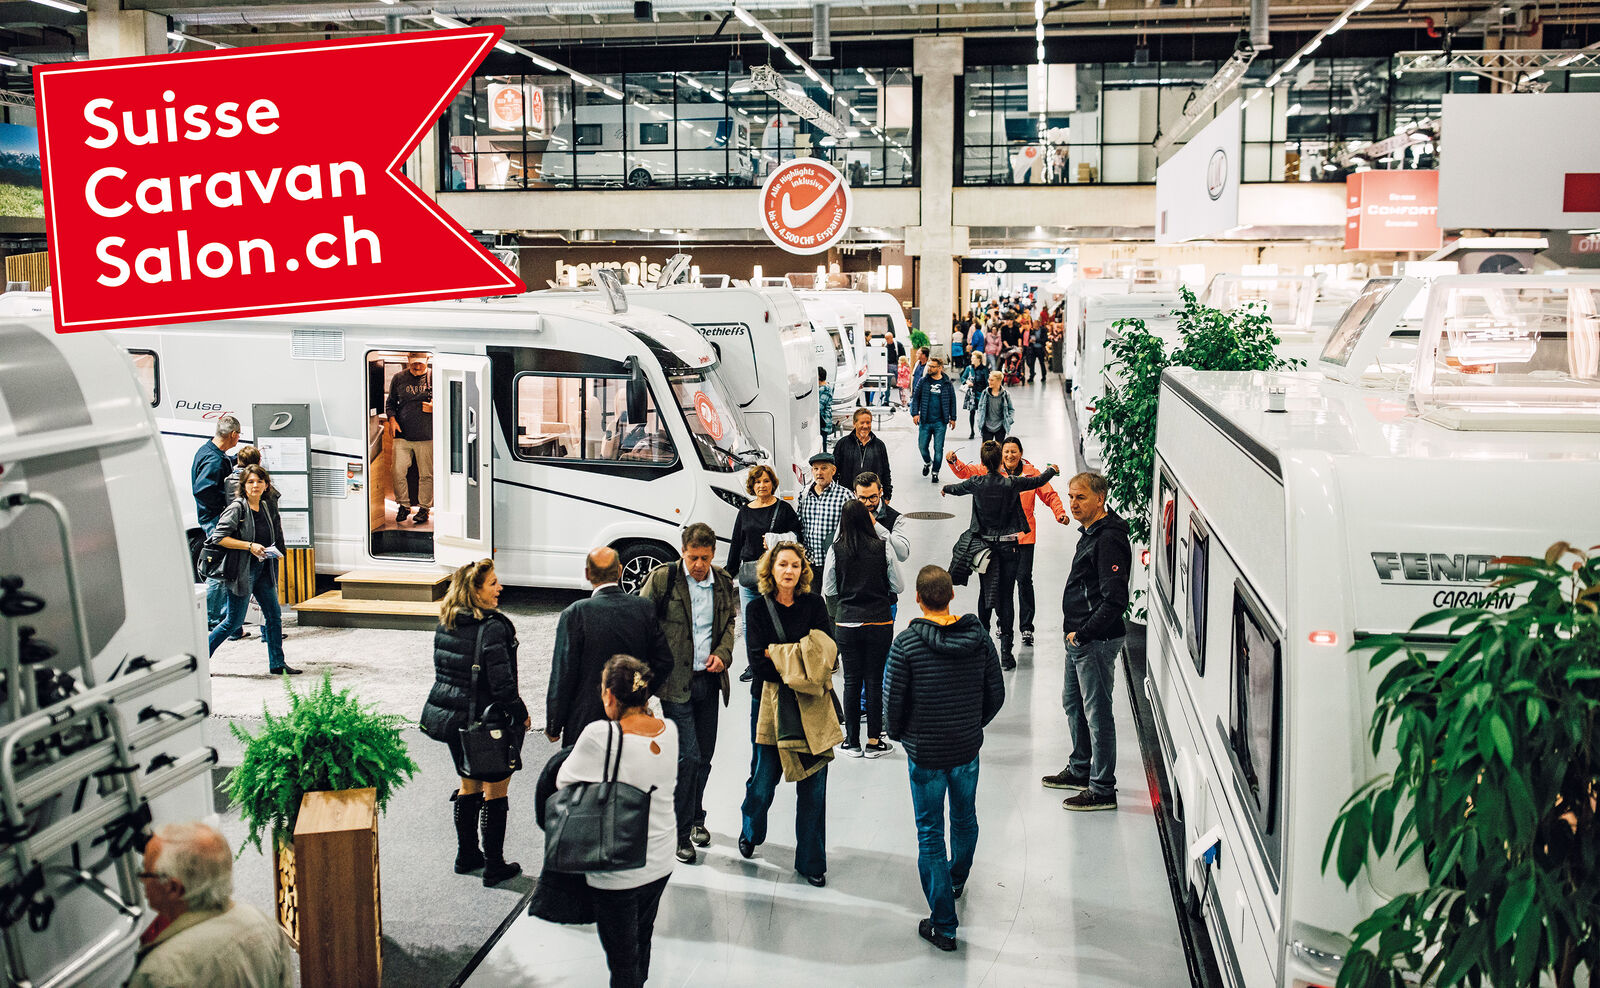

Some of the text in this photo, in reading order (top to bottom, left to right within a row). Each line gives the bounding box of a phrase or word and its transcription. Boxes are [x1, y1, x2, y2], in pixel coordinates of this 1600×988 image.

[771, 167, 815, 198] Alle Highlights
[790, 177, 824, 191] inklusive
[768, 210, 776, 220] bis
[772, 220, 780, 230] zu
[799, 236, 815, 245] CHF
[699, 327, 745, 336] Dethleffs
[175, 400, 223, 411] Pulse
[1432, 590, 1516, 610] CARAVAN
